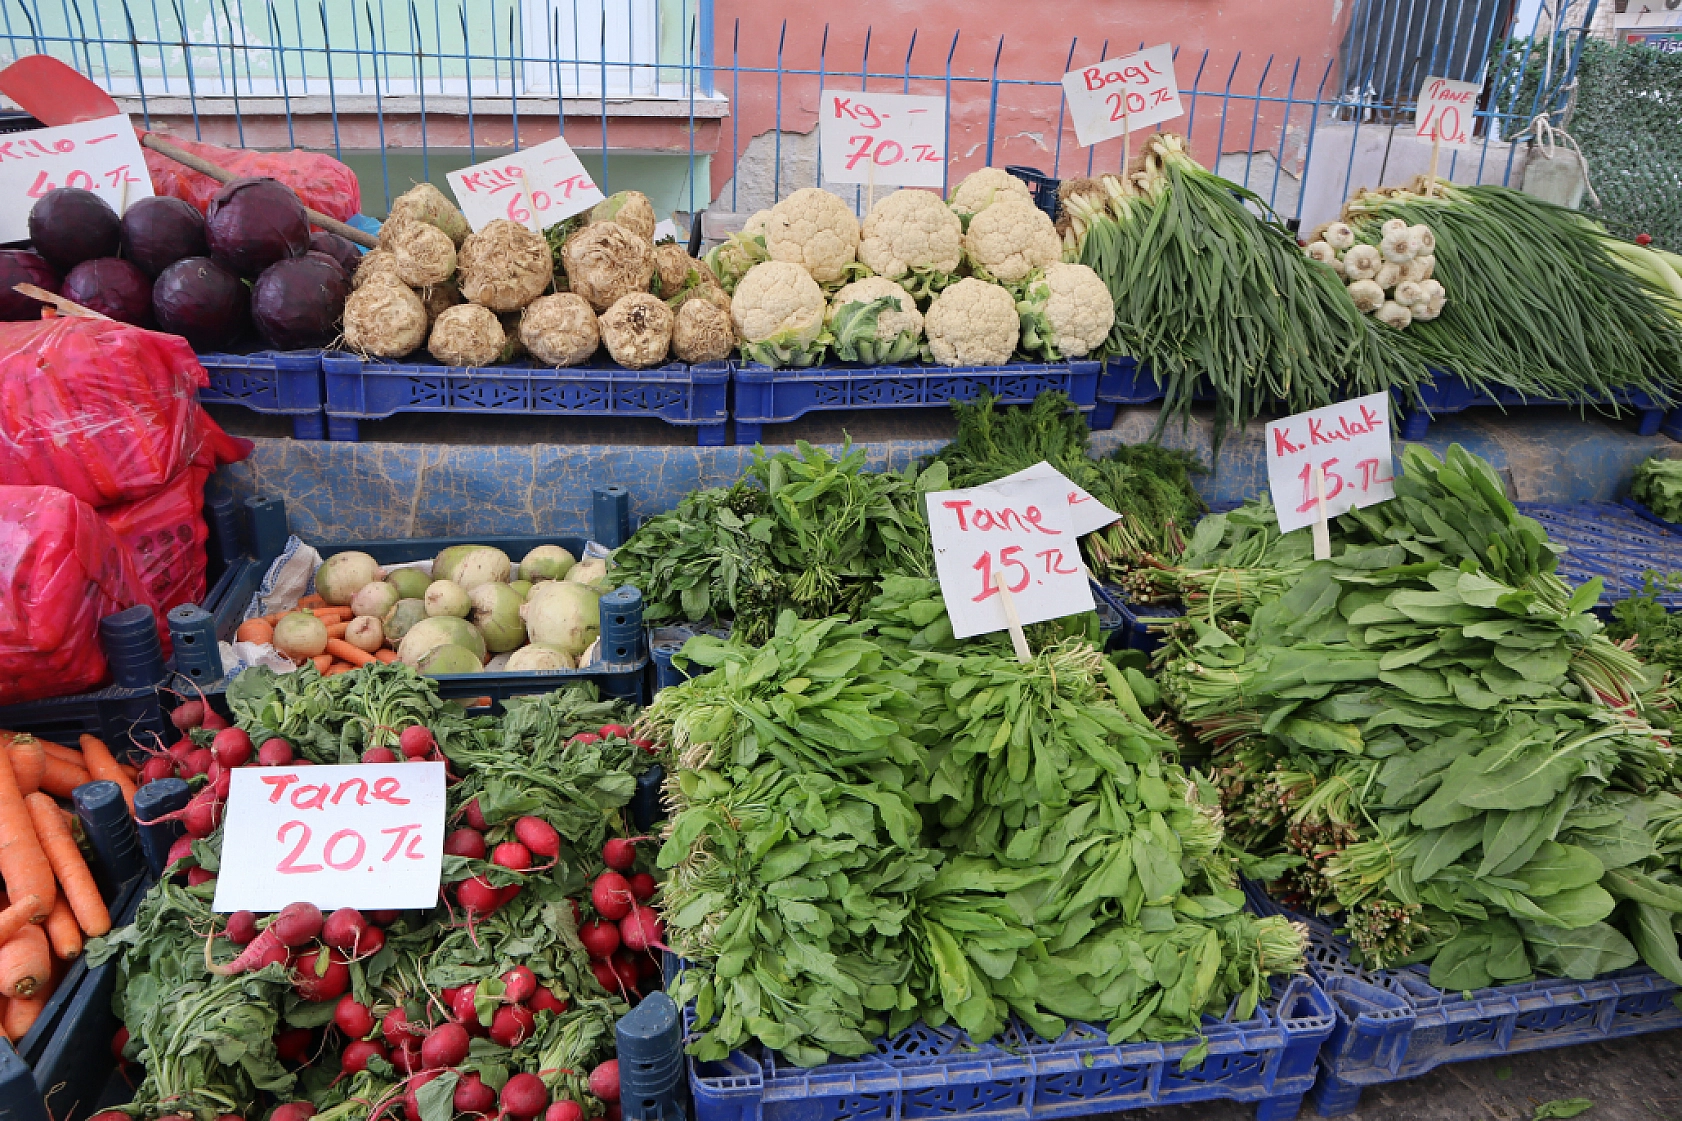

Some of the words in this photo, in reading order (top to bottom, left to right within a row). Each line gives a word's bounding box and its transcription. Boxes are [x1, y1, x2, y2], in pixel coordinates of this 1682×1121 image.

[1308, 404, 1384, 446] Kulak
[942, 499, 1063, 535] Tane
[259, 773, 411, 811] Tane
